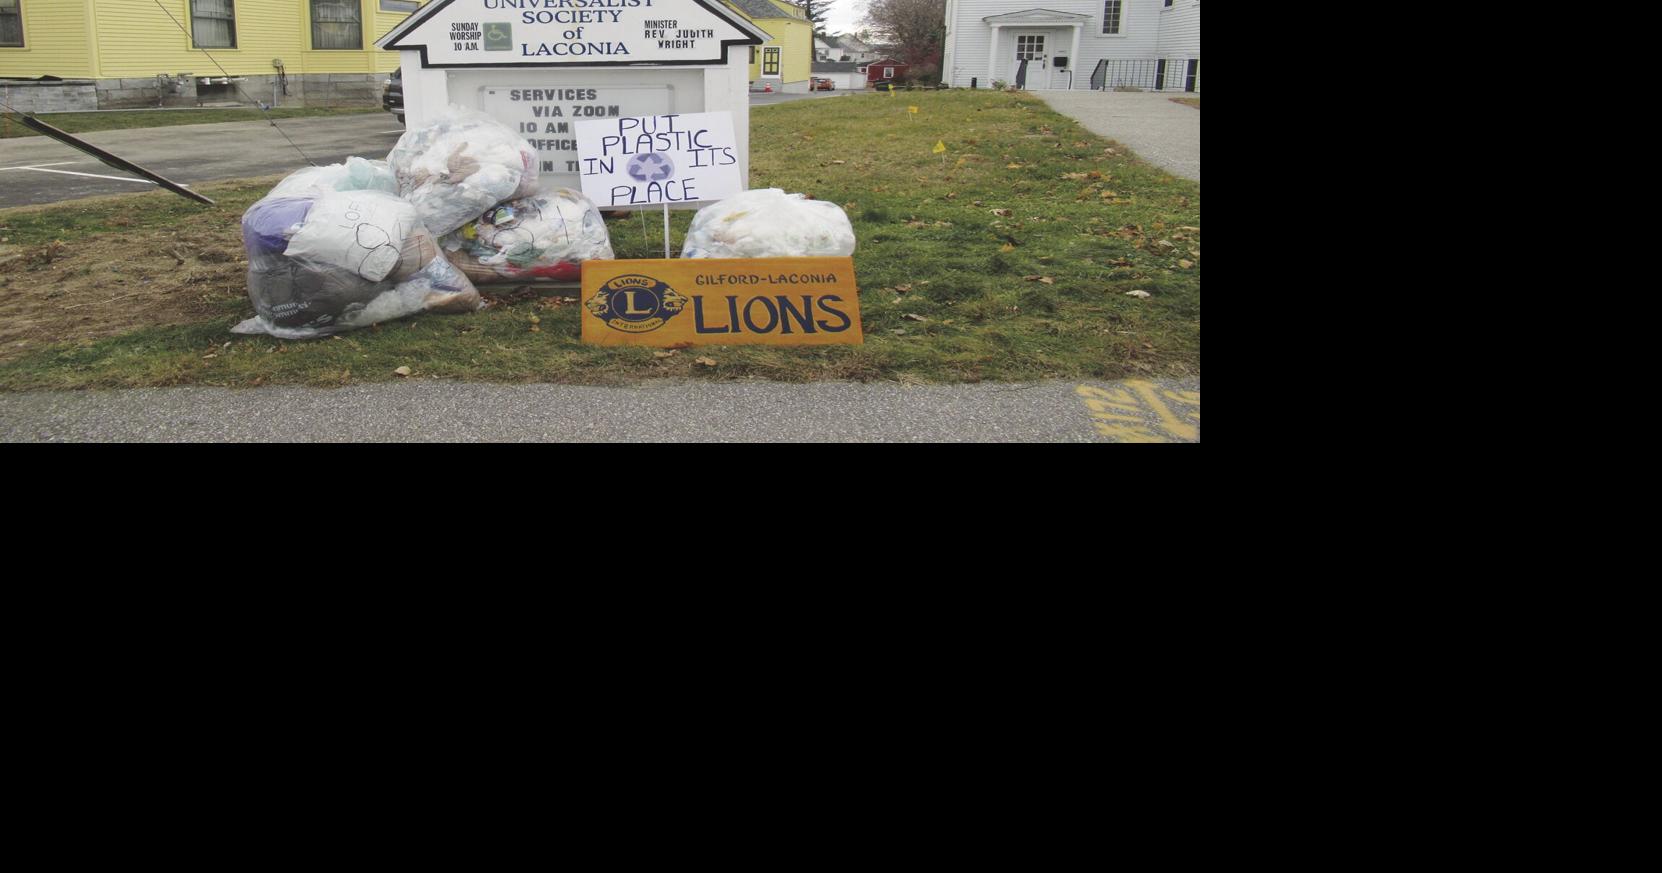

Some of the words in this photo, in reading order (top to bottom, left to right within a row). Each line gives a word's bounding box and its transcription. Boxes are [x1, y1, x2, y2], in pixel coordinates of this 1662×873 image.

[521, 10, 623, 24] SOCIETY
[451, 22, 479, 31] SUNDAY
[644, 19, 678, 29] MINISTER
[449, 31, 481, 40] WORSHIP
[563, 27, 584, 40] of
[644, 29, 665, 38] REV
[676, 29, 713, 38] JUDITH
[454, 42, 462, 51] 10
[521, 42, 630, 56] LACONIA
[658, 39, 695, 49] WRIGHT
[510, 88, 597, 101] SERVICES
[532, 105, 563, 117] VIA
[572, 105, 620, 117] ZOOM
[545, 122, 569, 133] AM
[619, 114, 681, 136] PUT
[602, 129, 712, 156] PLASTIC
[583, 157, 614, 175] IN
[687, 147, 736, 168] ITS
[611, 178, 699, 206] PLACE
[613, 277, 648, 288] LIONS
[695, 273, 837, 286] GILFORD-LACONIA
[624, 291, 653, 315] L
[691, 294, 852, 334] LIONS
